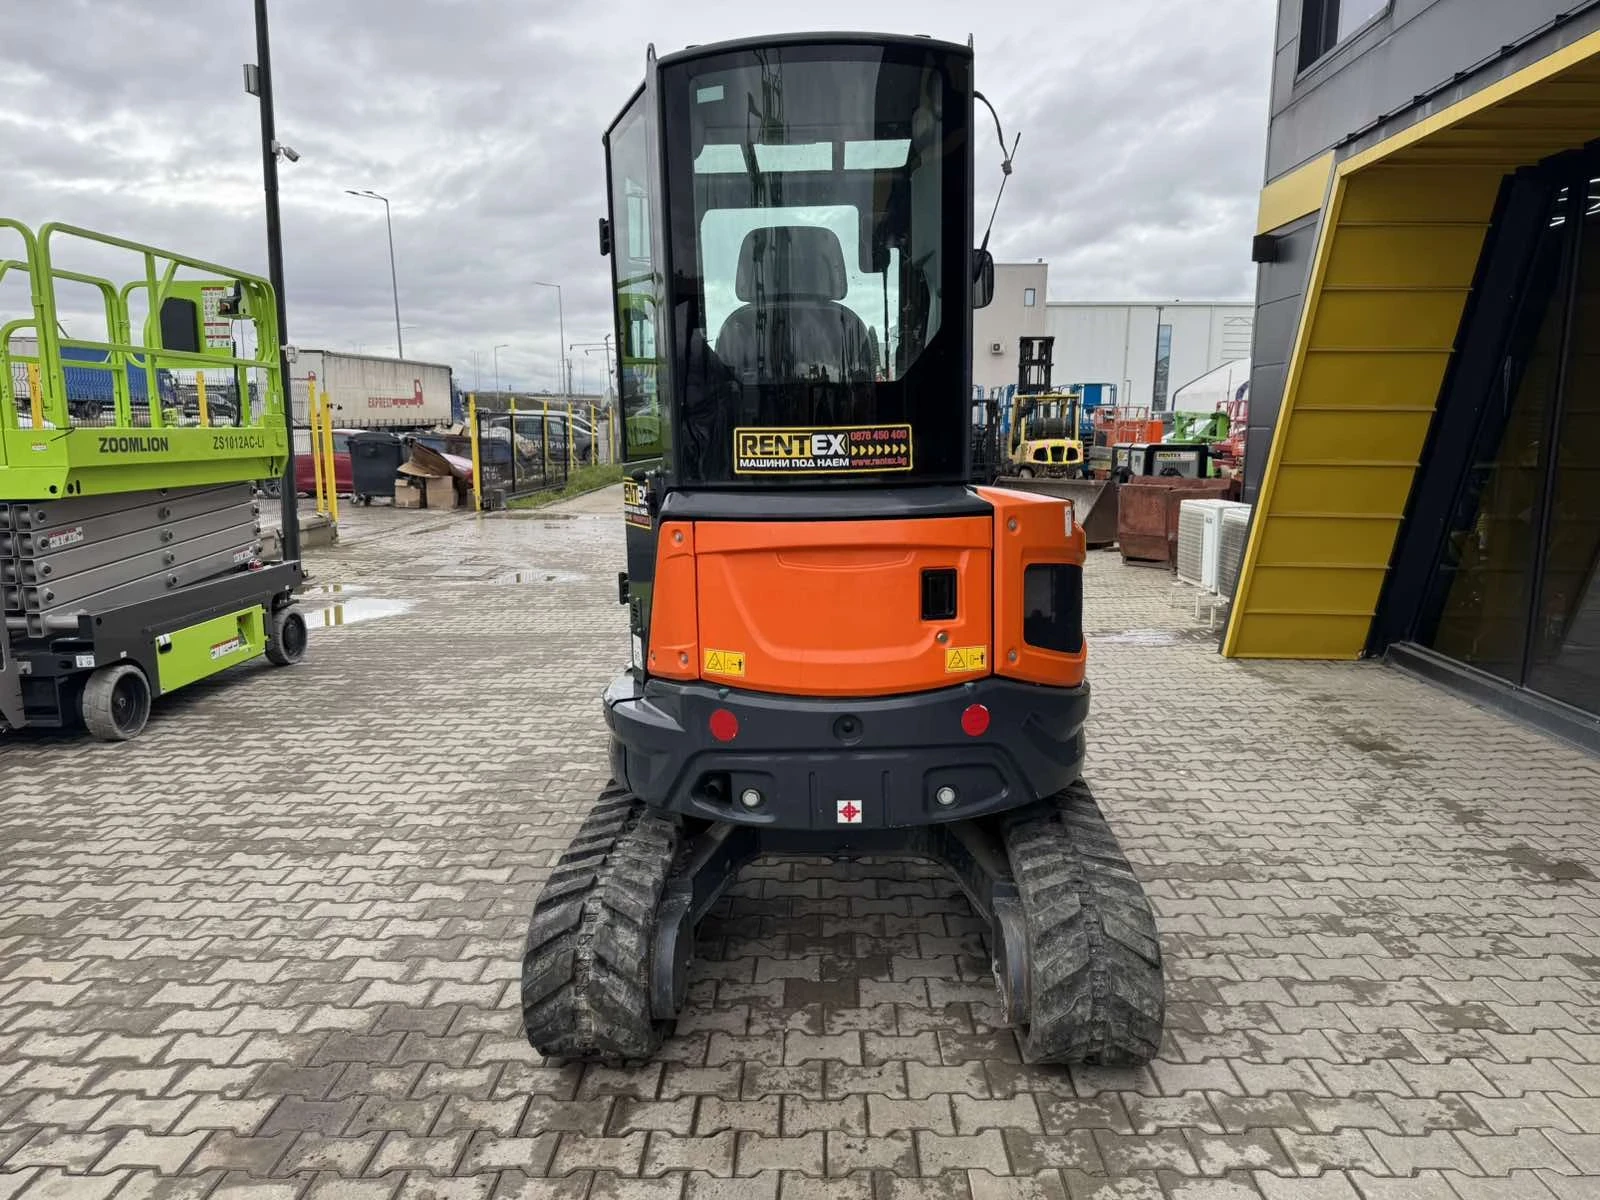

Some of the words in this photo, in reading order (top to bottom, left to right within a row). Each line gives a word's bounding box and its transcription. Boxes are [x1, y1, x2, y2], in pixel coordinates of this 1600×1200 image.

[98, 436, 169, 453] ZOOMLION
[742, 434, 846, 456] RENTEX
[740, 459, 790, 468] МАШИНИ
[792, 459, 815, 468] ПОД
[817, 458, 850, 467] НАЕМ
